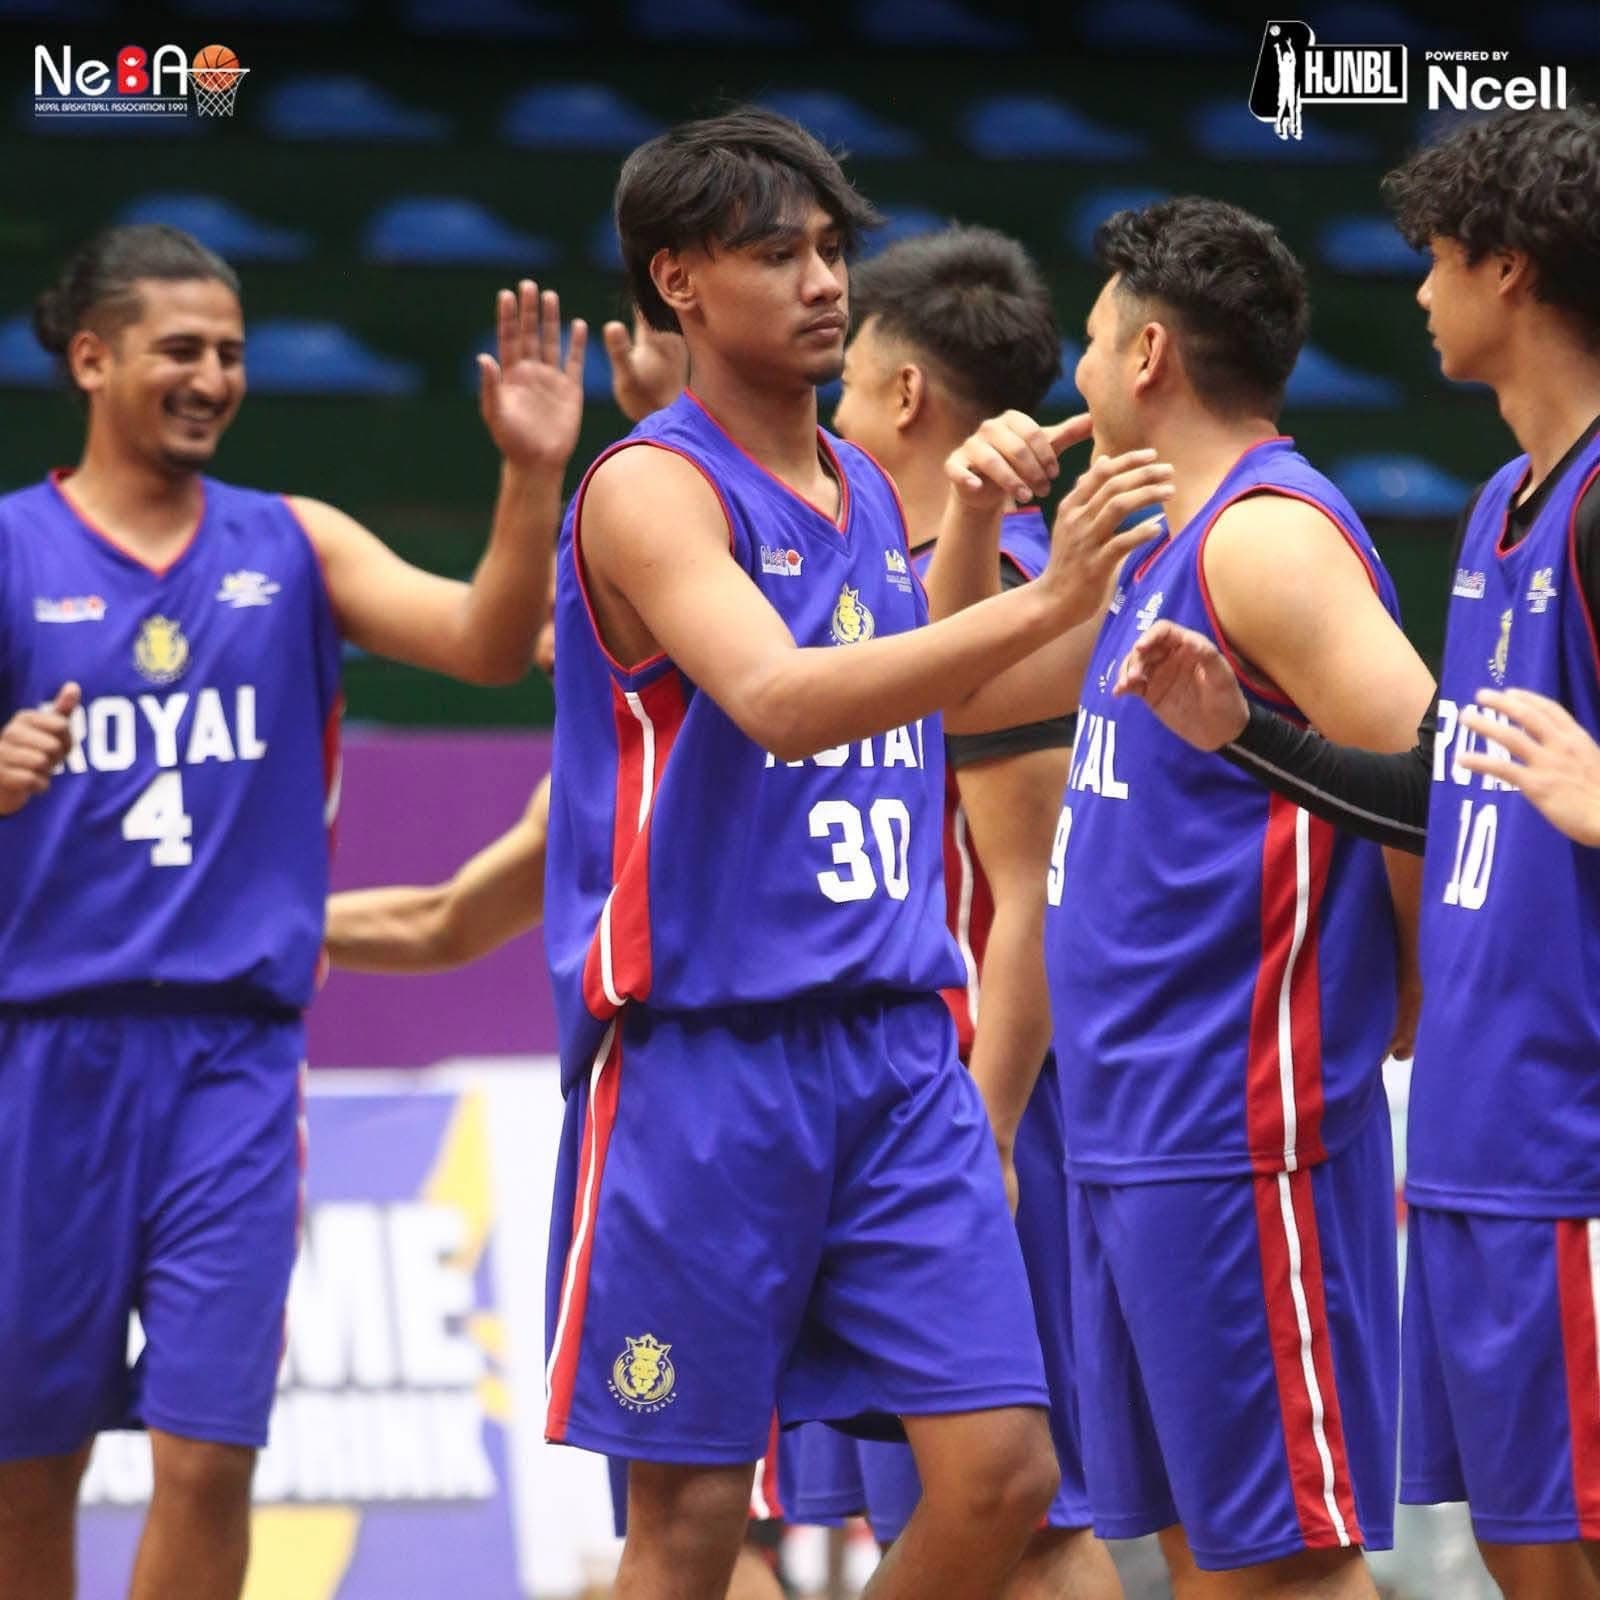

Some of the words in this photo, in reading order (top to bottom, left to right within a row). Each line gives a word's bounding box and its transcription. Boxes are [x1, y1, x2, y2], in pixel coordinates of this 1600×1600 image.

[122, 770, 193, 866] 4
[808, 798, 911, 903] 30
[1046, 805, 1073, 906] 9
[1443, 799, 1497, 911] 10
